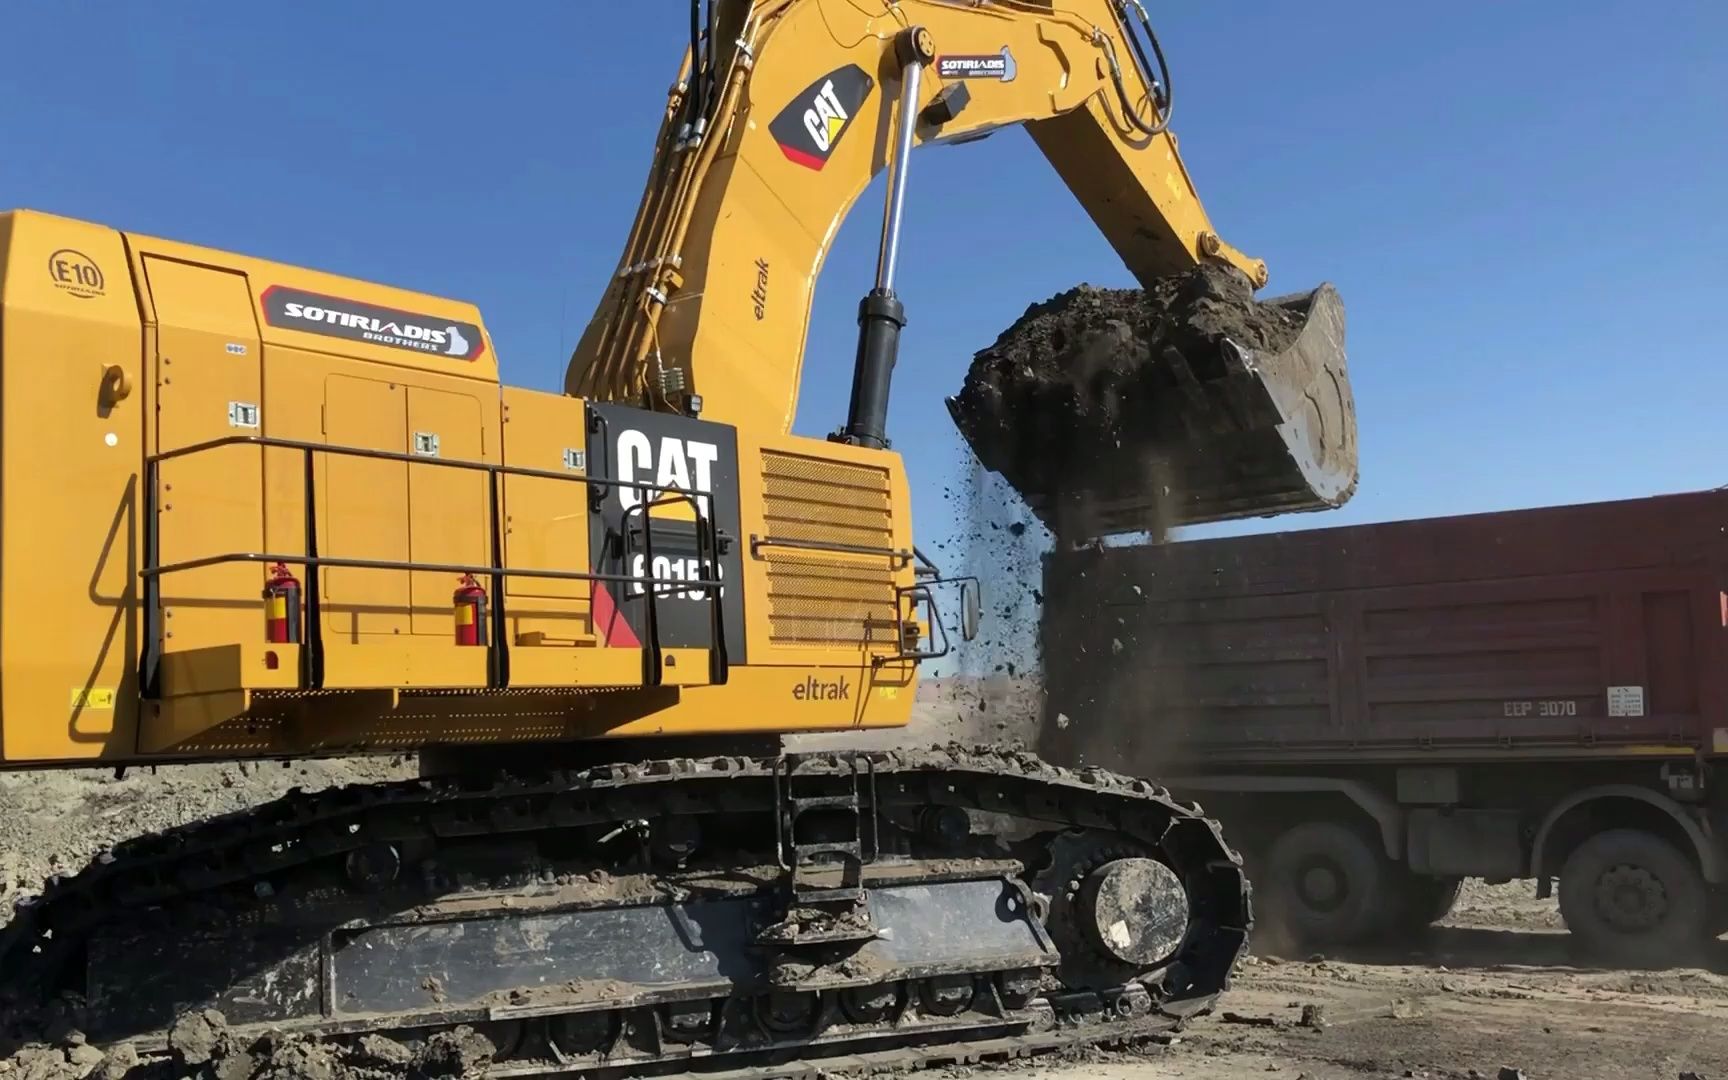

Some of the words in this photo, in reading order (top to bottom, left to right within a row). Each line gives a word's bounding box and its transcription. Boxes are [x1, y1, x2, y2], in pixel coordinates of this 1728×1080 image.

[941, 59, 1005, 70] SOTIRIADIS
[803, 79, 849, 152] CAT
[55, 259, 99, 287] E10
[751, 257, 769, 321] eltrak
[284, 302, 447, 344] SOTIRIADIS
[362, 331, 439, 352] BROTHERS
[616, 429, 718, 524] CAT
[791, 675, 850, 701] eltrak
[1503, 701, 1533, 717] EEP
[1539, 701, 1577, 717] 3070
